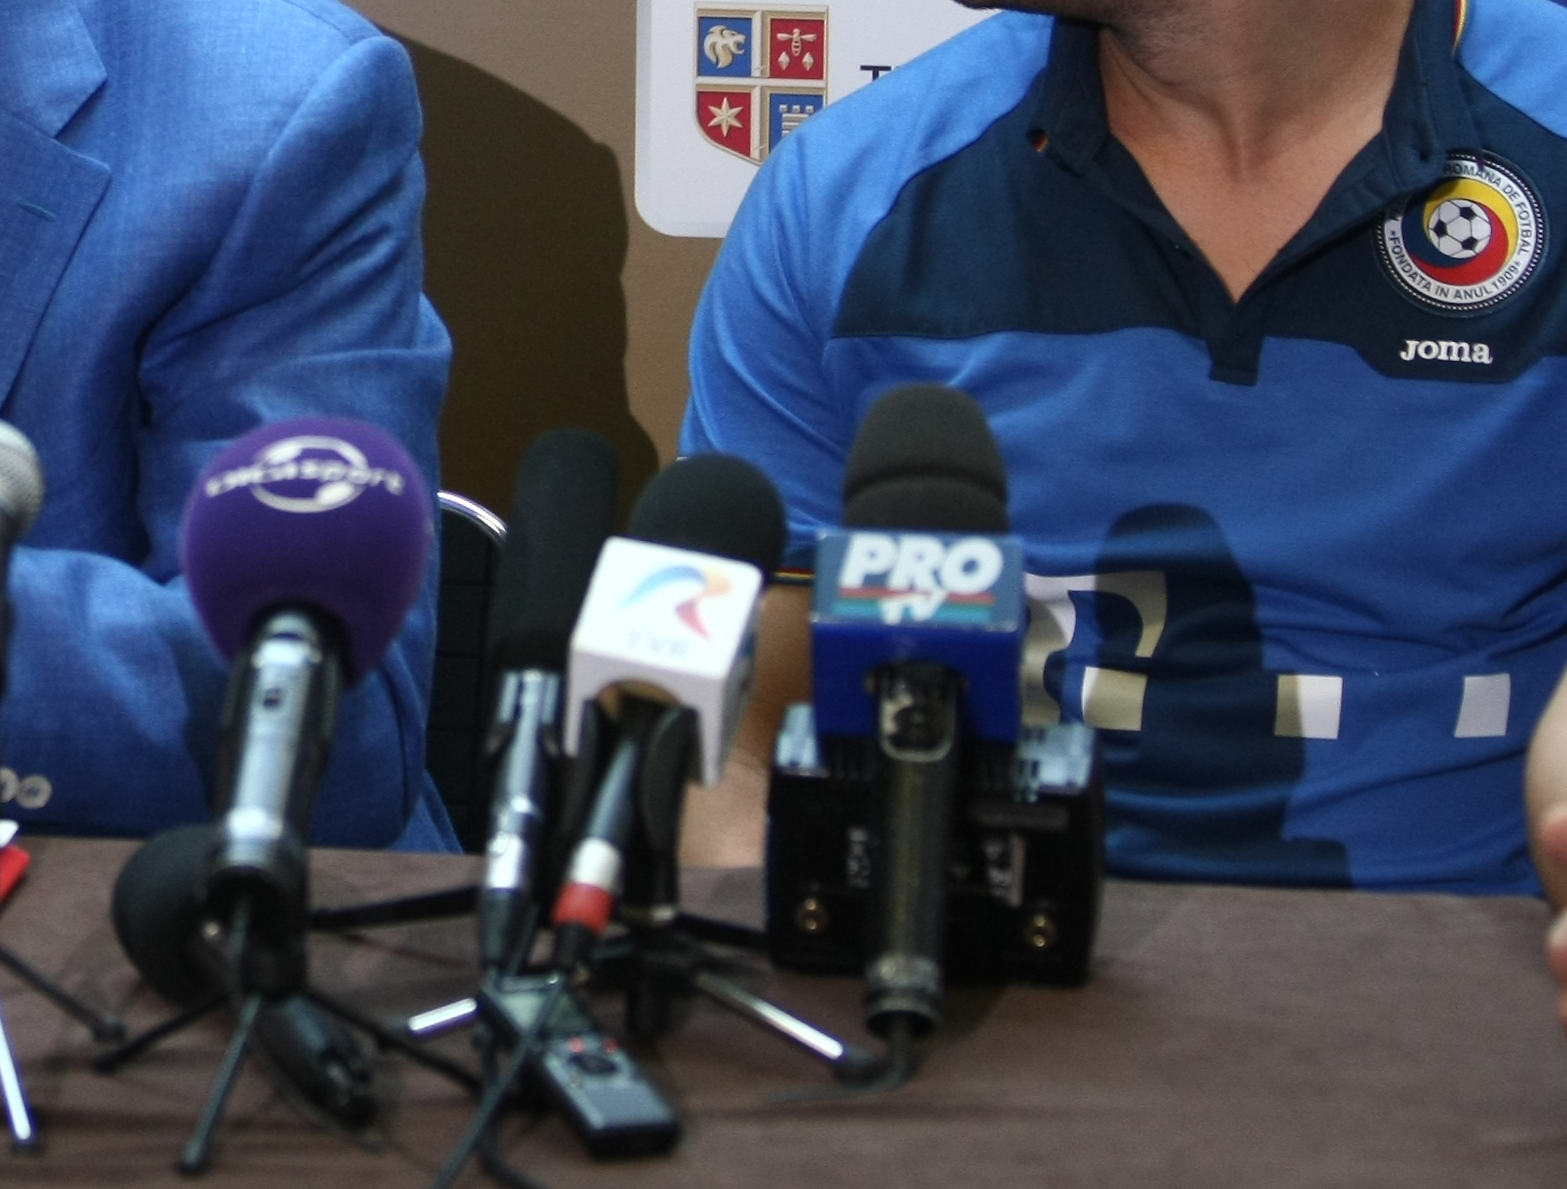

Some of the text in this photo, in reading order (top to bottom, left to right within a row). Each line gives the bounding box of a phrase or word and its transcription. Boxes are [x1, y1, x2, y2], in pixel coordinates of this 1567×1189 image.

[1503, 184, 1518, 202] DE
[1516, 202, 1532, 255] FOTBAL
[1389, 236, 1519, 300] FONDATA IN ANUL 1909
[839, 533, 1003, 594] PRO
